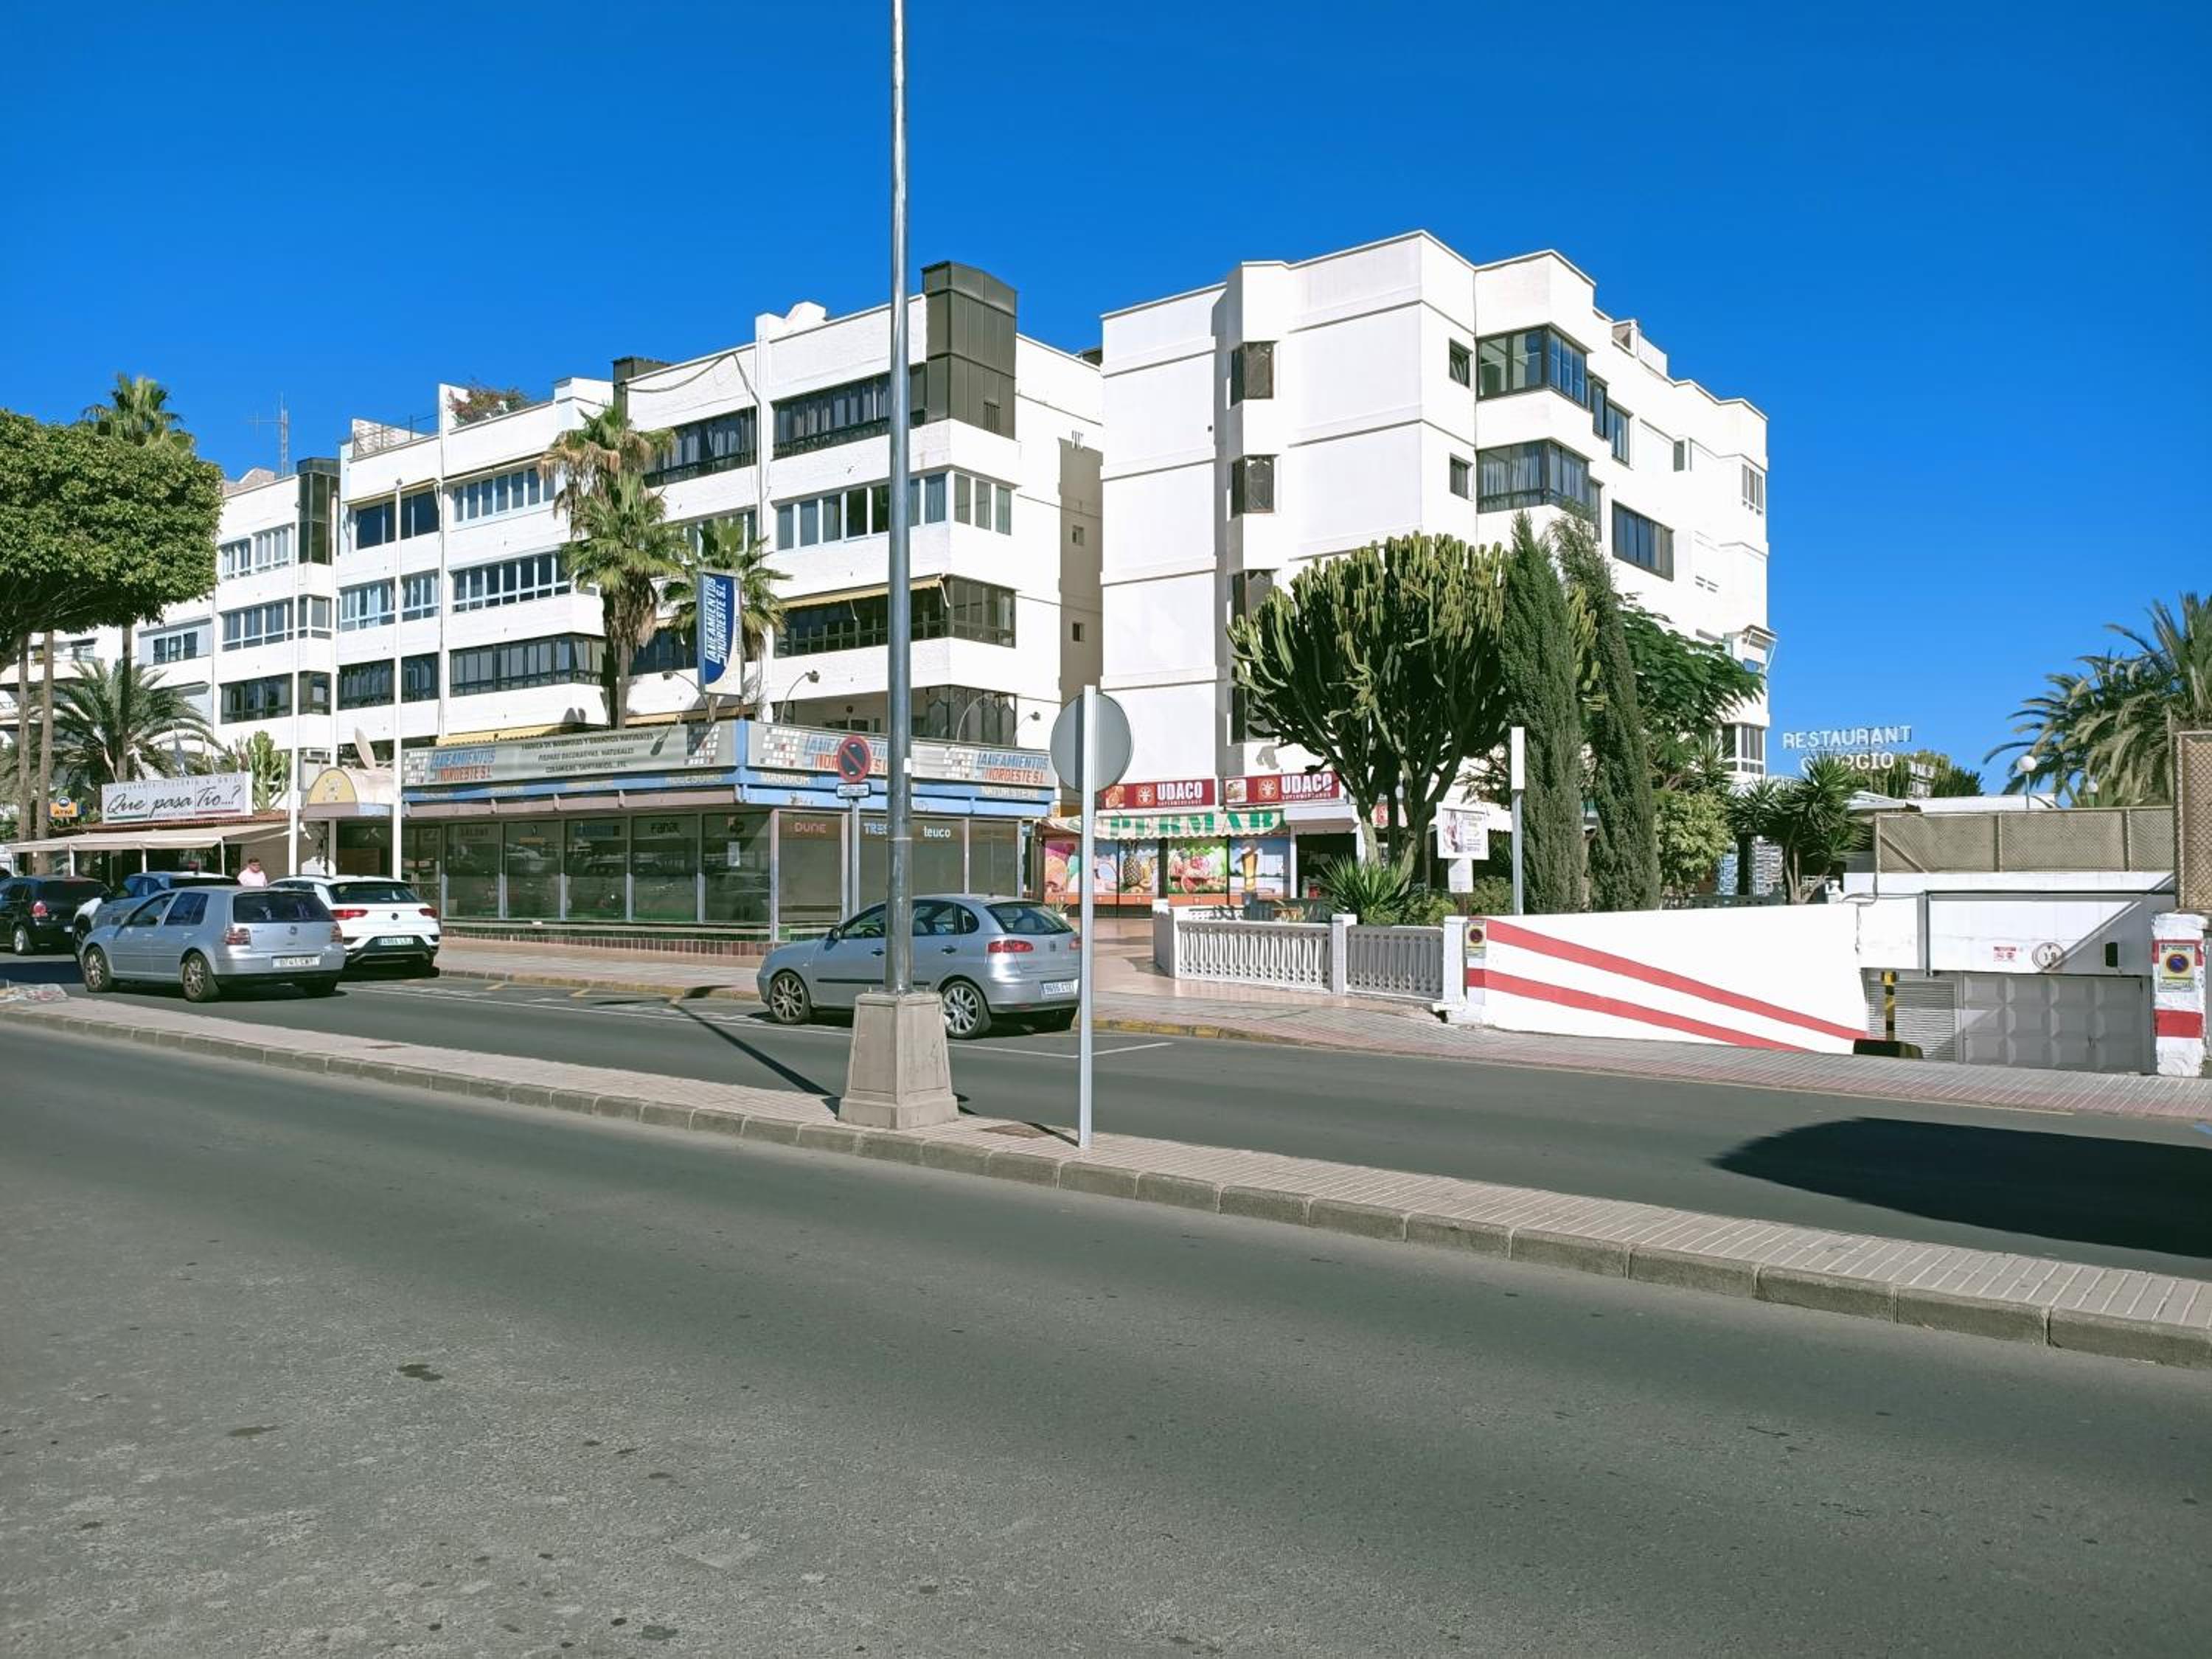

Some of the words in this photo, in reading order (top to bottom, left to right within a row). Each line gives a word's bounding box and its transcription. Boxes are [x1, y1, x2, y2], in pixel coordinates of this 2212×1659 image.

[1782, 726, 1911, 749] RESTAURANT
[1157, 782, 1203, 800] UDACO
[1281, 773, 1333, 793] UDACO
[107, 793, 145, 814] Que
[149, 797, 193, 818] pasa
[923, 825, 951, 838] teuco
